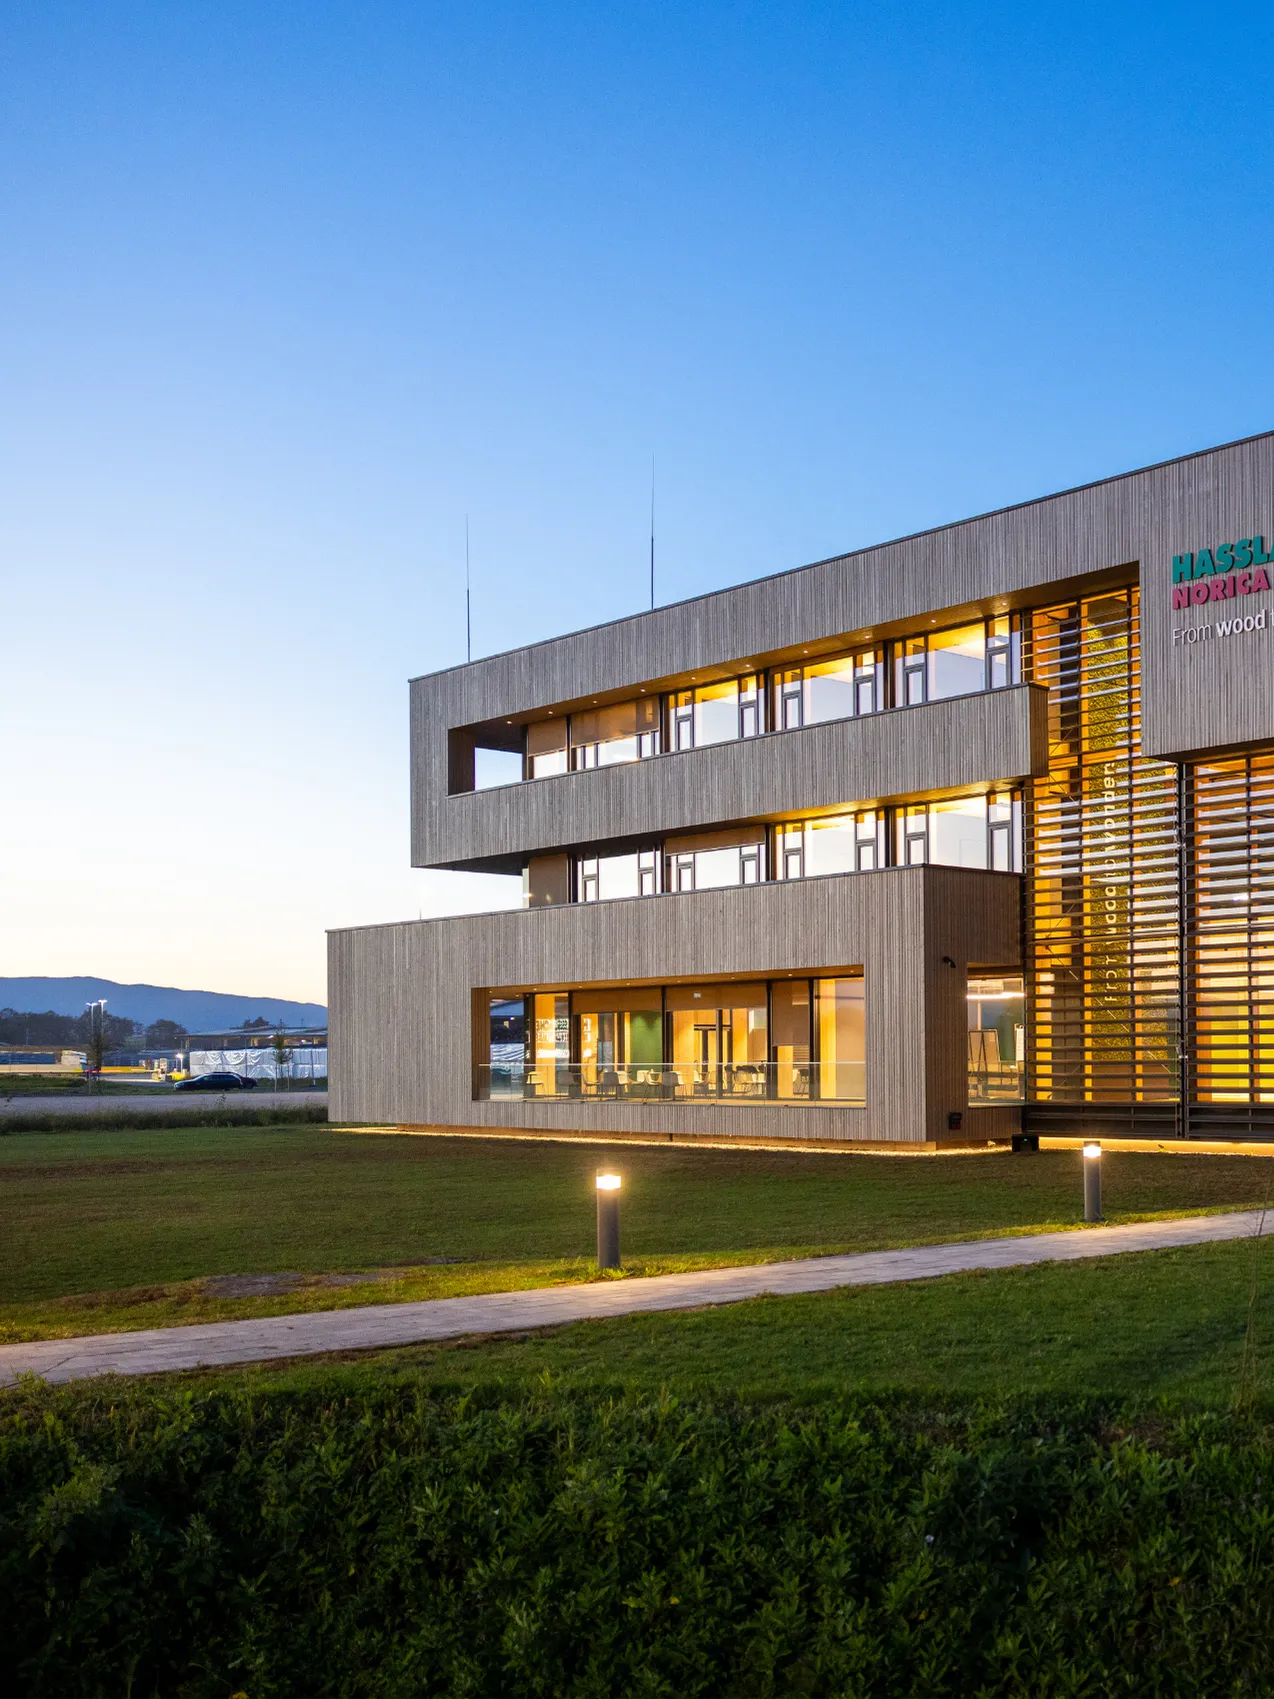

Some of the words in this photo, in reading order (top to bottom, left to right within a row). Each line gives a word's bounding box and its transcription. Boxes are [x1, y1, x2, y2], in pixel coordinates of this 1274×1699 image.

[1172, 569, 1270, 610] NORICA
[1172, 622, 1212, 646] From
[1216, 609, 1266, 637] wood
